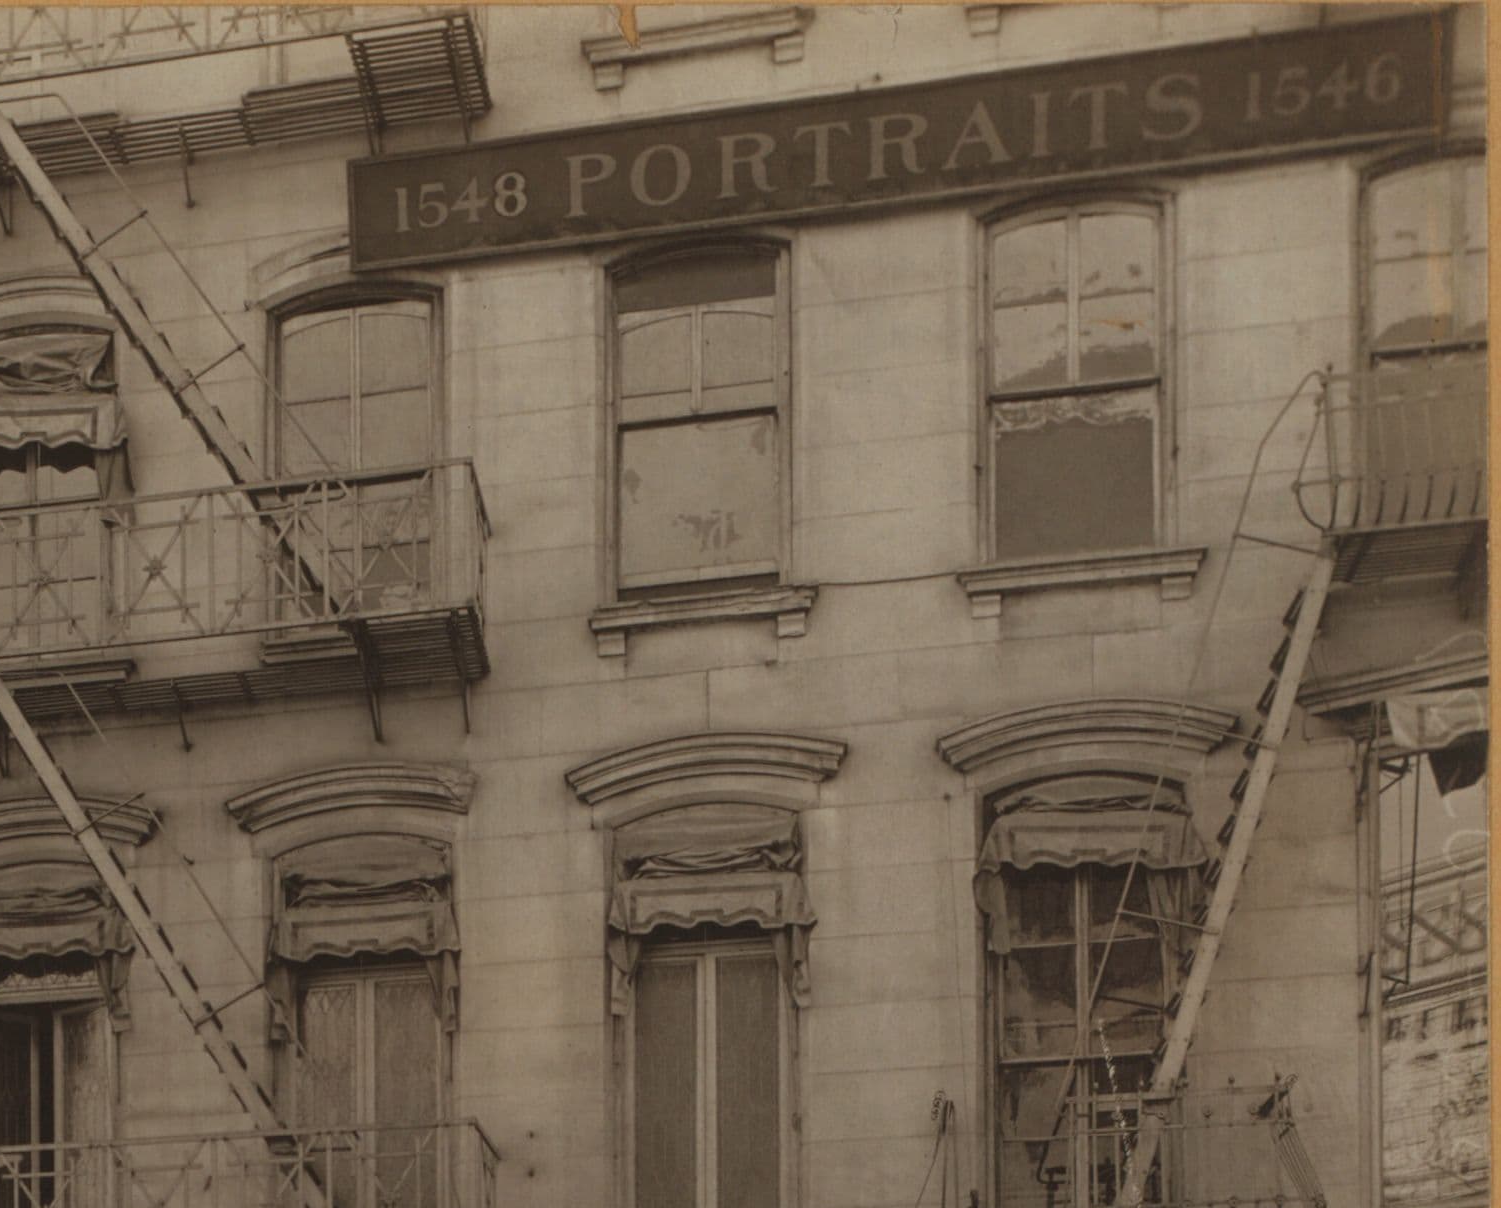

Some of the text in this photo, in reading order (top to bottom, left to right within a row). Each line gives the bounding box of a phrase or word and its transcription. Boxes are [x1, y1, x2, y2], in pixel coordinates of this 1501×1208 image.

[394, 52, 1402, 233] 1548 PORTRAITS 1546
